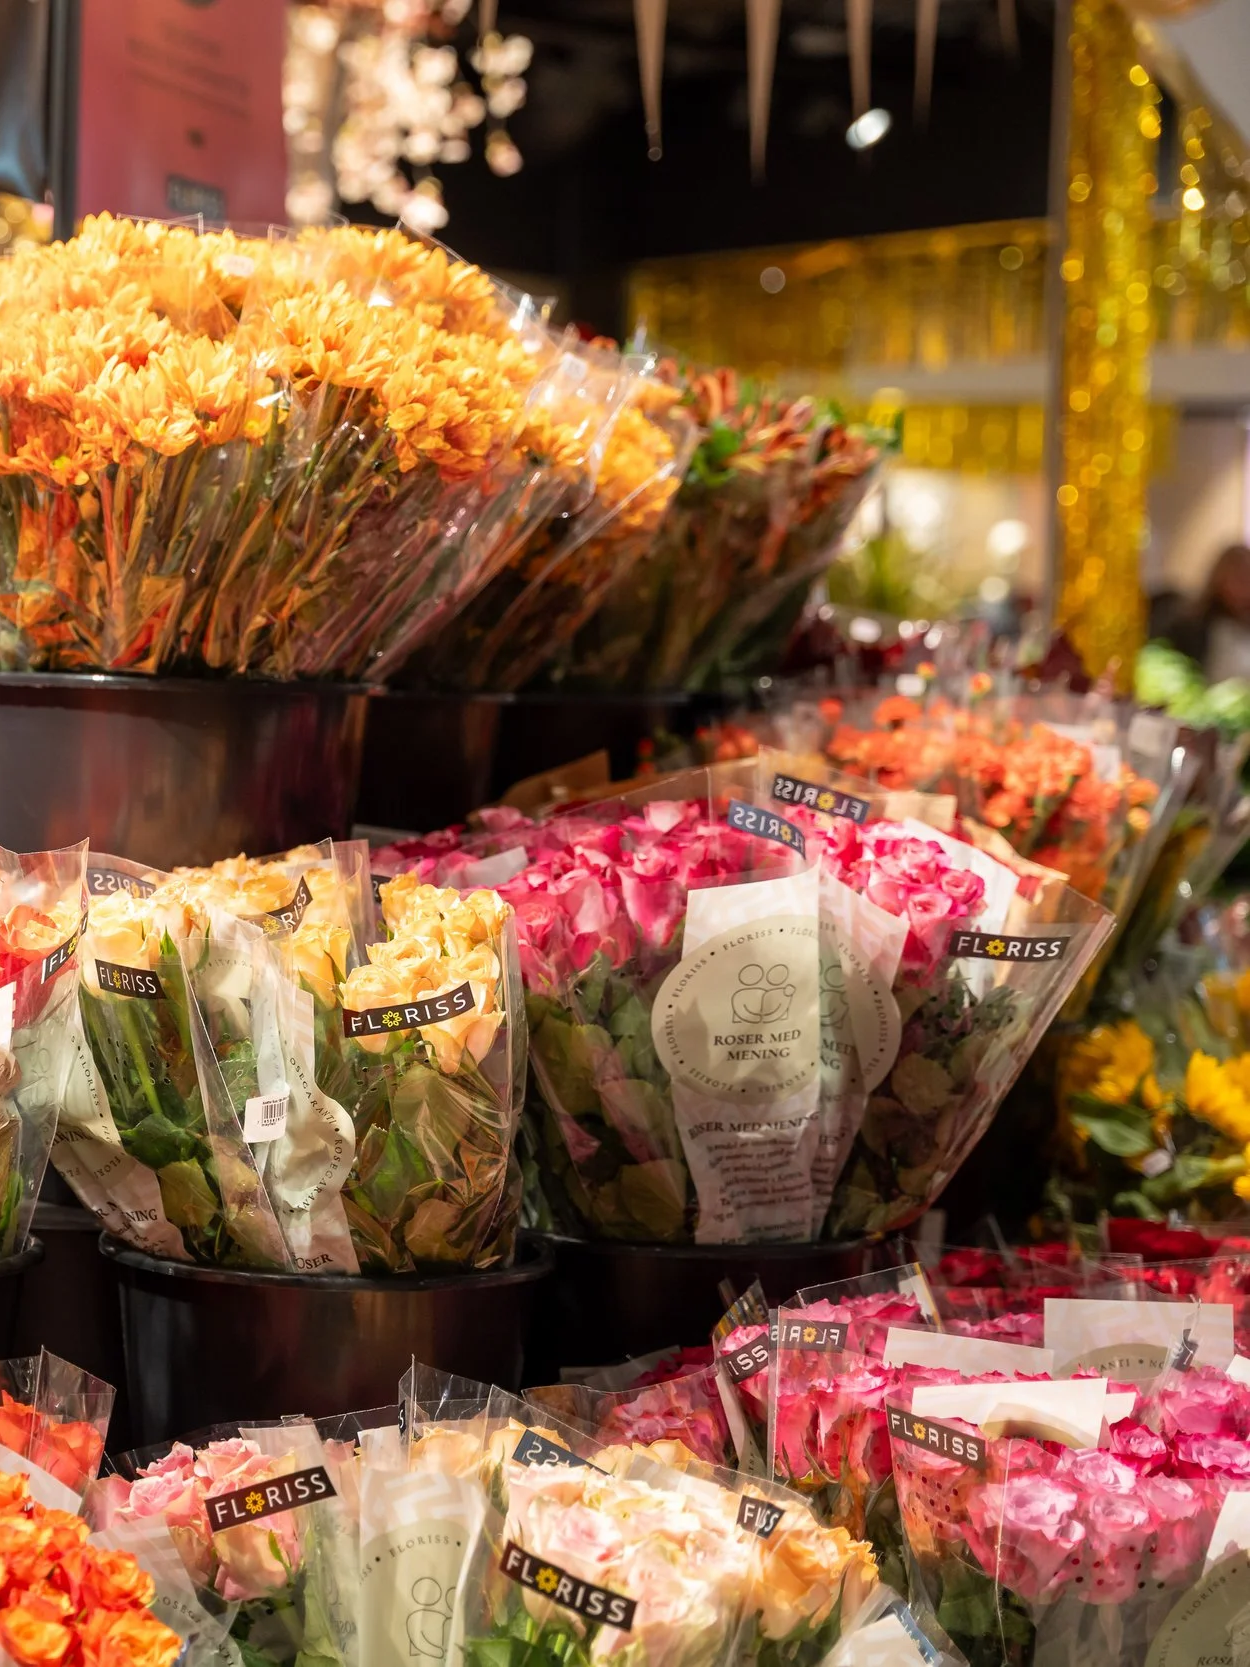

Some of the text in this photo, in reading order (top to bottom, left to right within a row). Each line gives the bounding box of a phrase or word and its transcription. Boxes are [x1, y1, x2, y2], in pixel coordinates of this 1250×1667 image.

[723, 928, 774, 951] FLORISS
[956, 936, 1062, 958] FLORISS
[99, 966, 158, 994] FLORISS
[672, 958, 708, 998] FLORISS
[351, 991, 467, 1033] FLORISS
[665, 1013, 681, 1057] FLORISS
[713, 1028, 802, 1046] ROSER MED
[725, 1047, 791, 1062] MENING
[78, 1053, 100, 1107] FLORISS
[289, 1057, 338, 1126] OSEGARANTI
[295, 1252, 334, 1271] OSER
[890, 1413, 979, 1462] FLORISS
[214, 1473, 327, 1524] FLORISS
[388, 1534, 451, 1559] FLORISS
[505, 1550, 627, 1624] FLORISS
